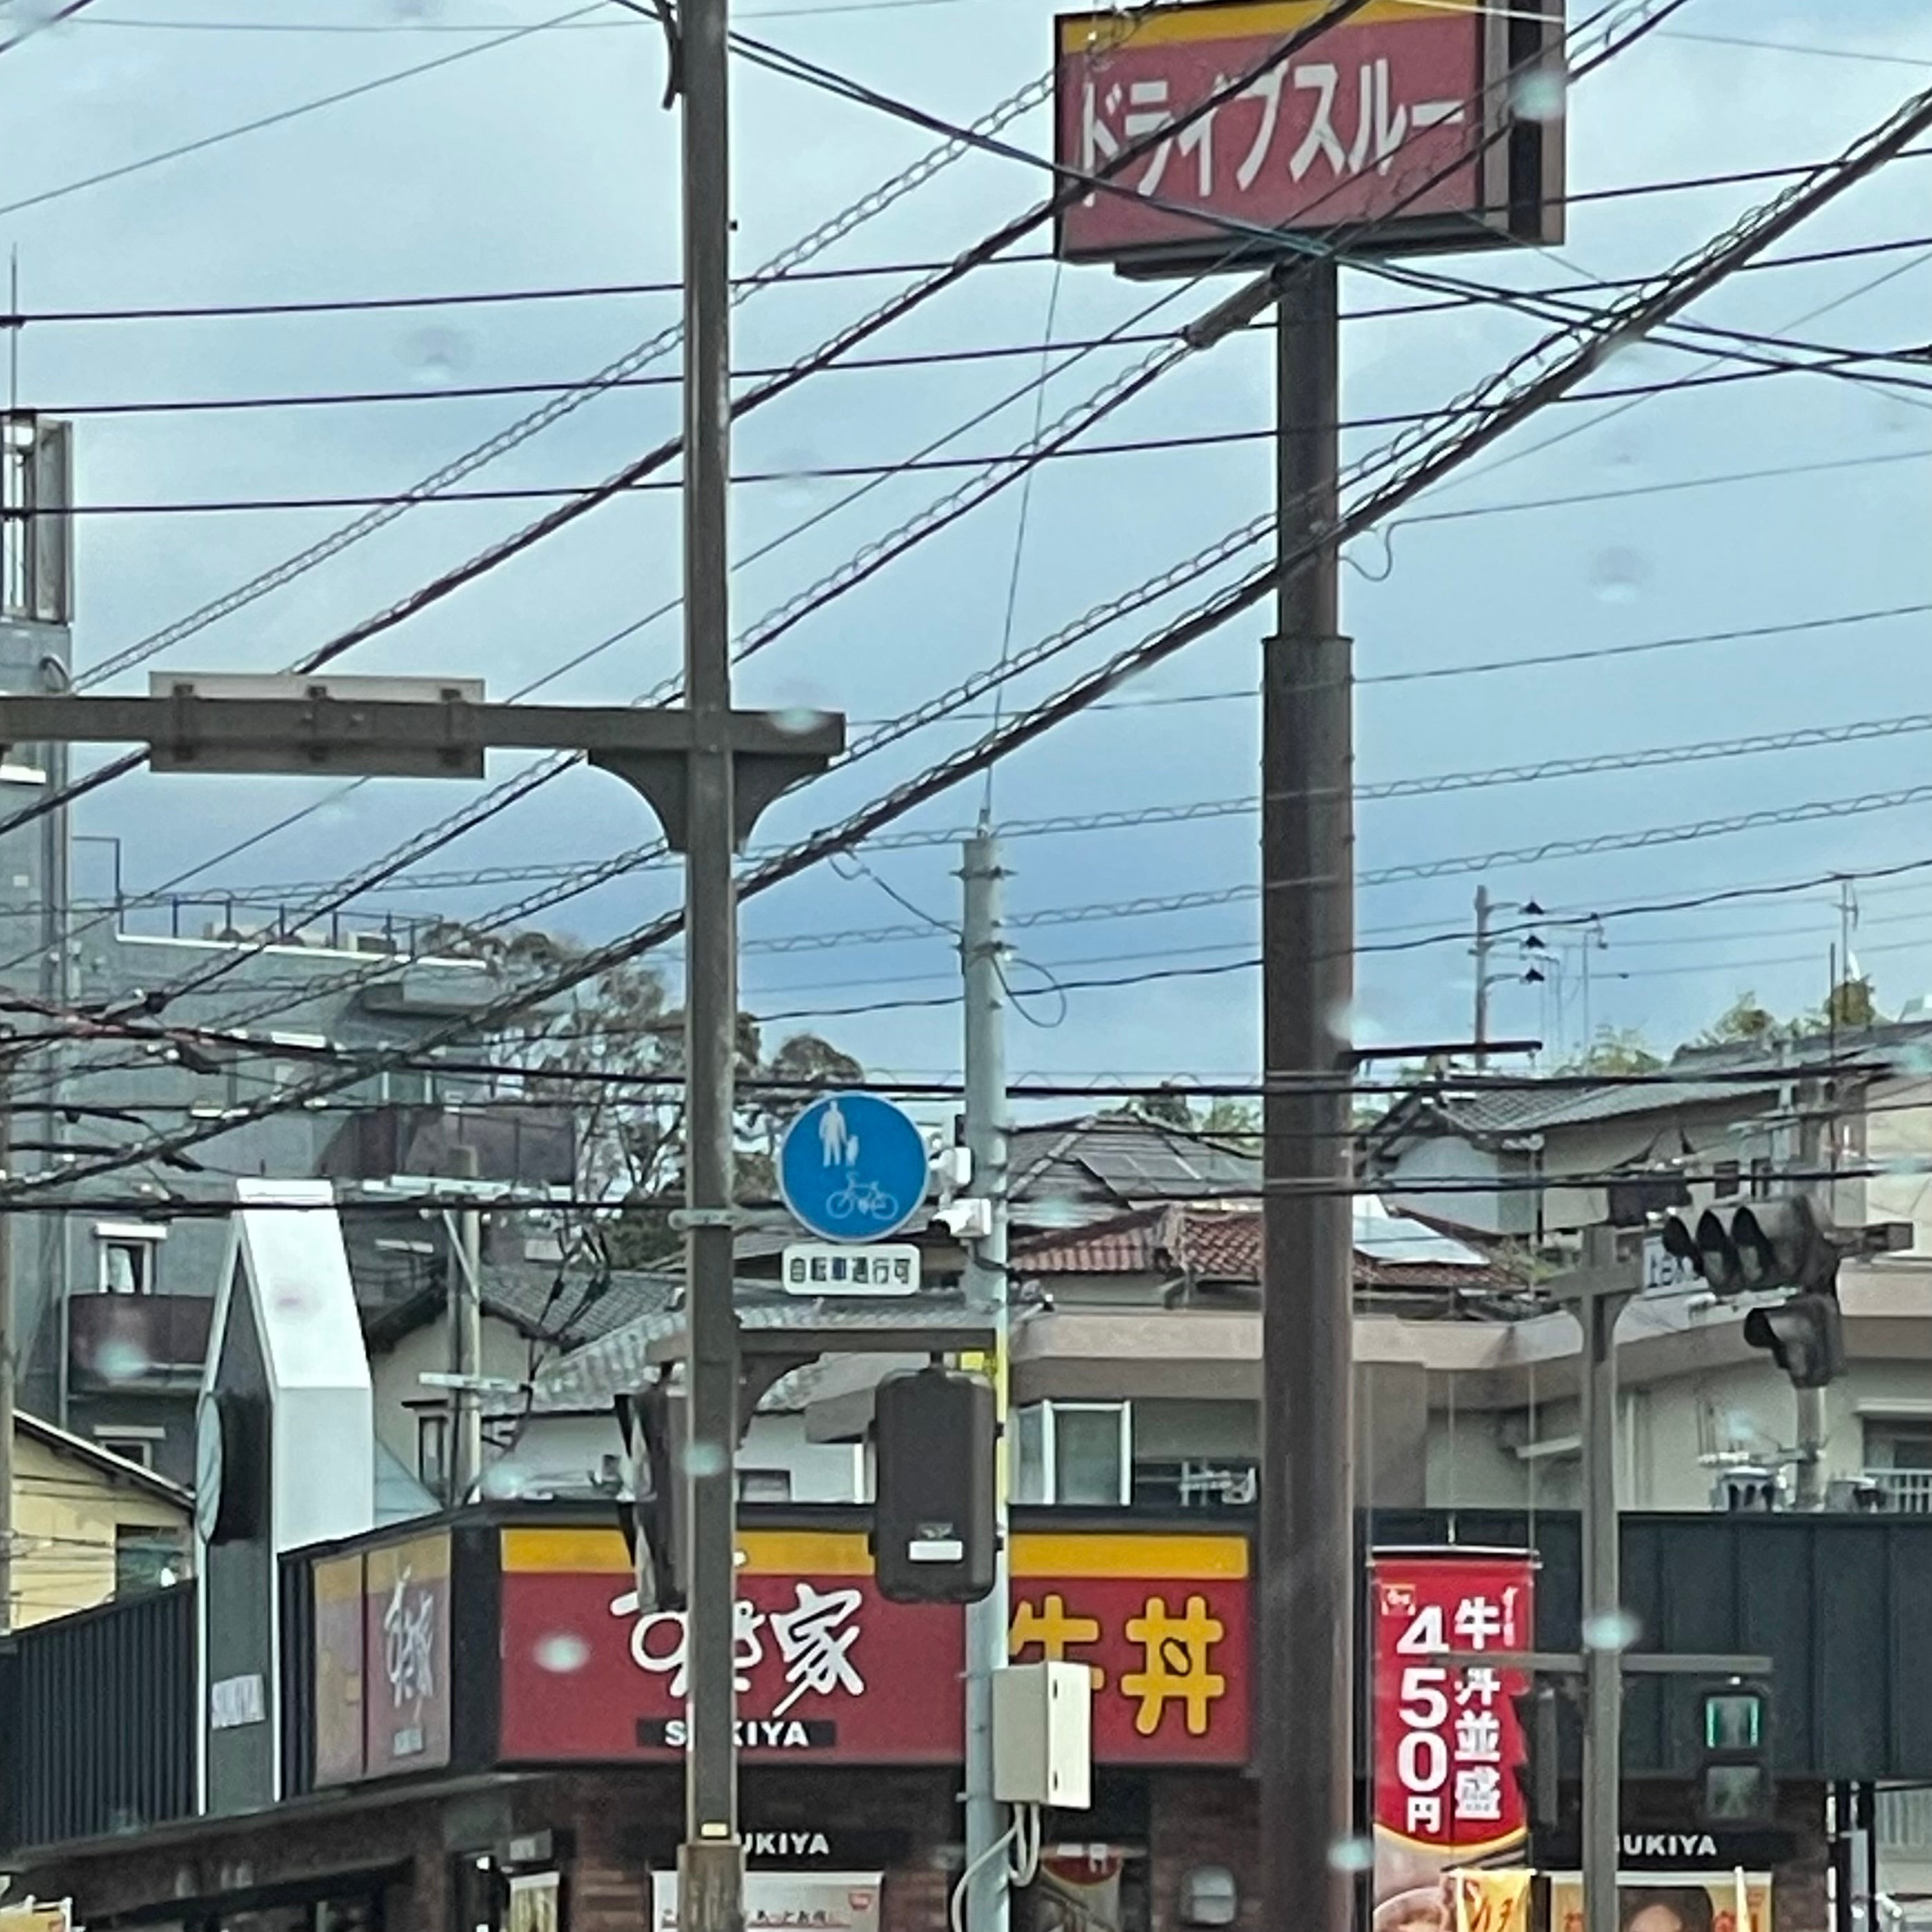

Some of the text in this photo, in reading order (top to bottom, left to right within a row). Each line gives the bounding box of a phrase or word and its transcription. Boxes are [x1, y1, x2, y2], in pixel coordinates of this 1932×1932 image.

[1082, 59, 1465, 207] ドライブスルー
[790, 1256, 911, 1284] 自転車通行可
[1009, 1595, 1225, 1735] 牛丼
[665, 1720, 809, 1747] SIYA
[1396, 1605, 1450, 1833] 450円
[1454, 1596, 1502, 1820] 牛丼並盛
[742, 1832, 830, 1855] UKIYA
[1616, 1835, 1718, 1856] UKIYA
